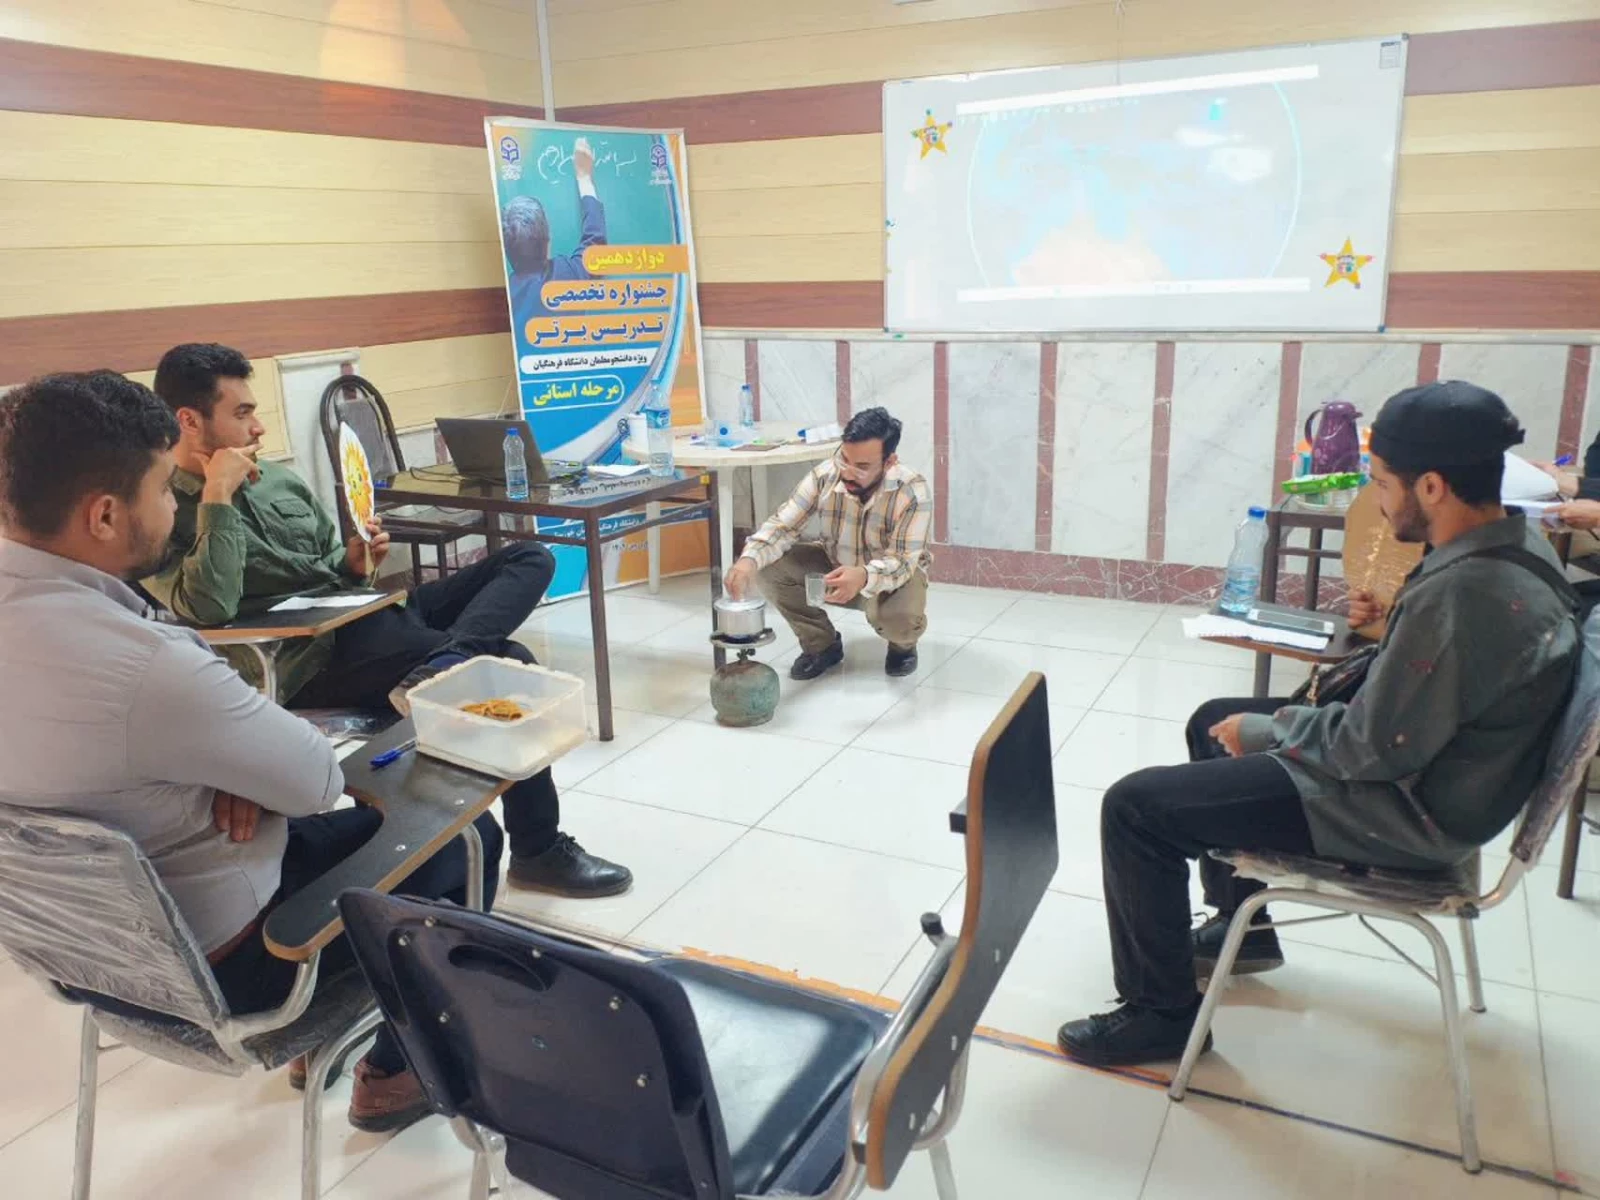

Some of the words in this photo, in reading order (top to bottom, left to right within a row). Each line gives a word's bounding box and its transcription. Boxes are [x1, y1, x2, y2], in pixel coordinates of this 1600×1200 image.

[587, 247, 665, 271] دوازدهمین
[546, 284, 605, 308] تخصصی
[609, 282, 667, 305] جشنواره
[590, 316, 664, 341] تدریس
[533, 359, 563, 371] فرهنگیان
[564, 357, 588, 368] دانشگاه
[533, 382, 577, 406] استانی
[580, 381, 620, 400] مرحله
